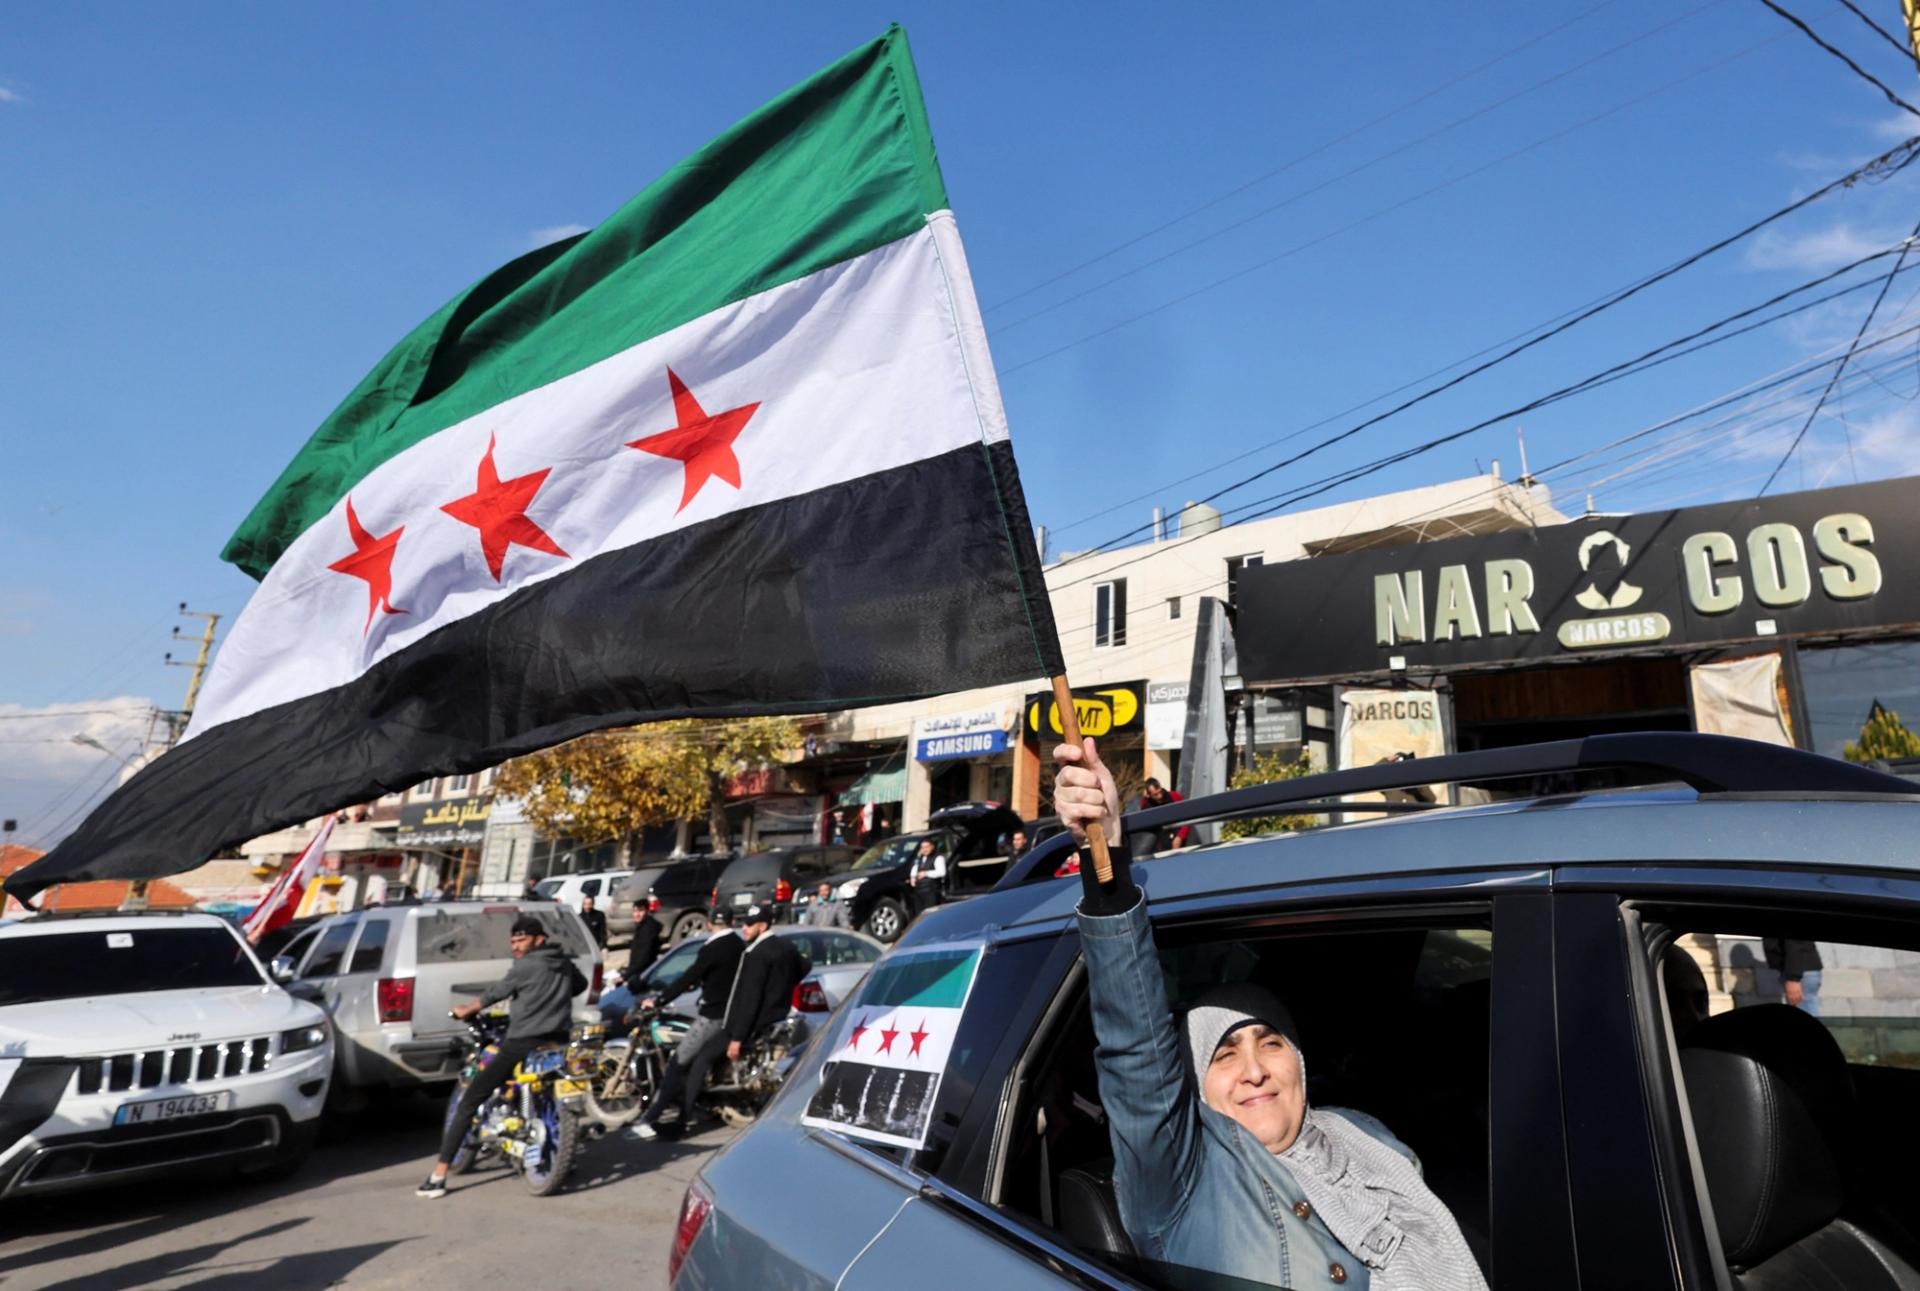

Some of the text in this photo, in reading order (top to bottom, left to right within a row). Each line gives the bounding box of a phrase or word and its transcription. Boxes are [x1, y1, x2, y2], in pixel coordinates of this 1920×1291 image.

[1568, 616, 1657, 644] NARCOS
[1070, 706, 1103, 729] MT
[1351, 700, 1434, 721] NARCOS
[926, 733, 993, 757] SAMSUNG
[130, 1095, 219, 1122] N 194433
